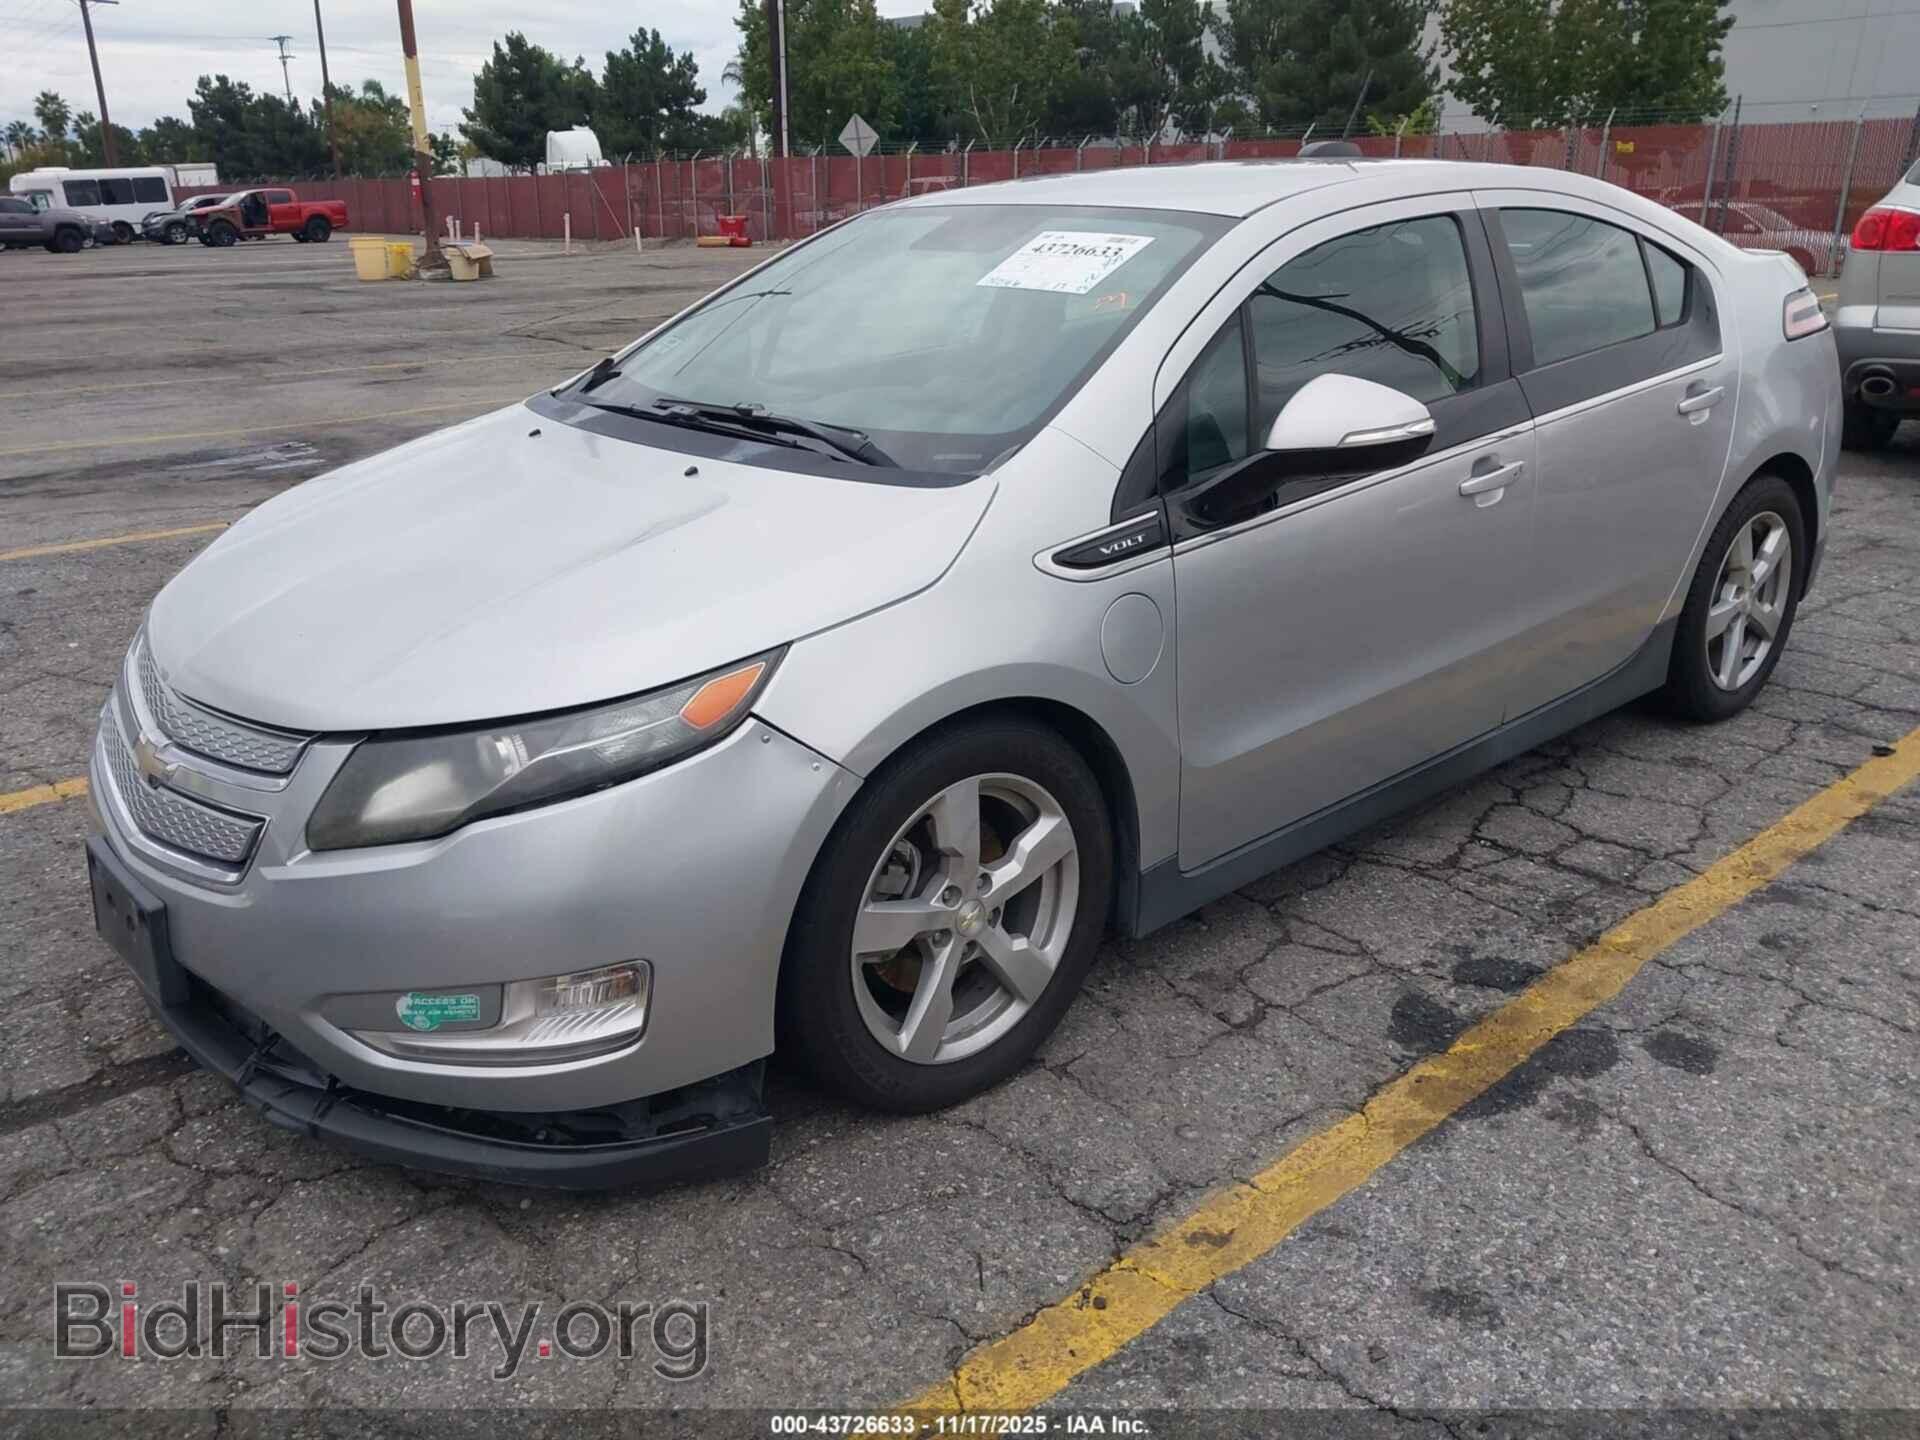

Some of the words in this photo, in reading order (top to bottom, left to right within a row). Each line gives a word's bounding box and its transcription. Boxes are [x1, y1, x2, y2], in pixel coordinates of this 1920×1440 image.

[1031, 241, 1124, 257] 43726633
[1099, 534, 1146, 555] VOLT
[414, 997, 456, 1005] ACCESS
[460, 996, 476, 1004] OK
